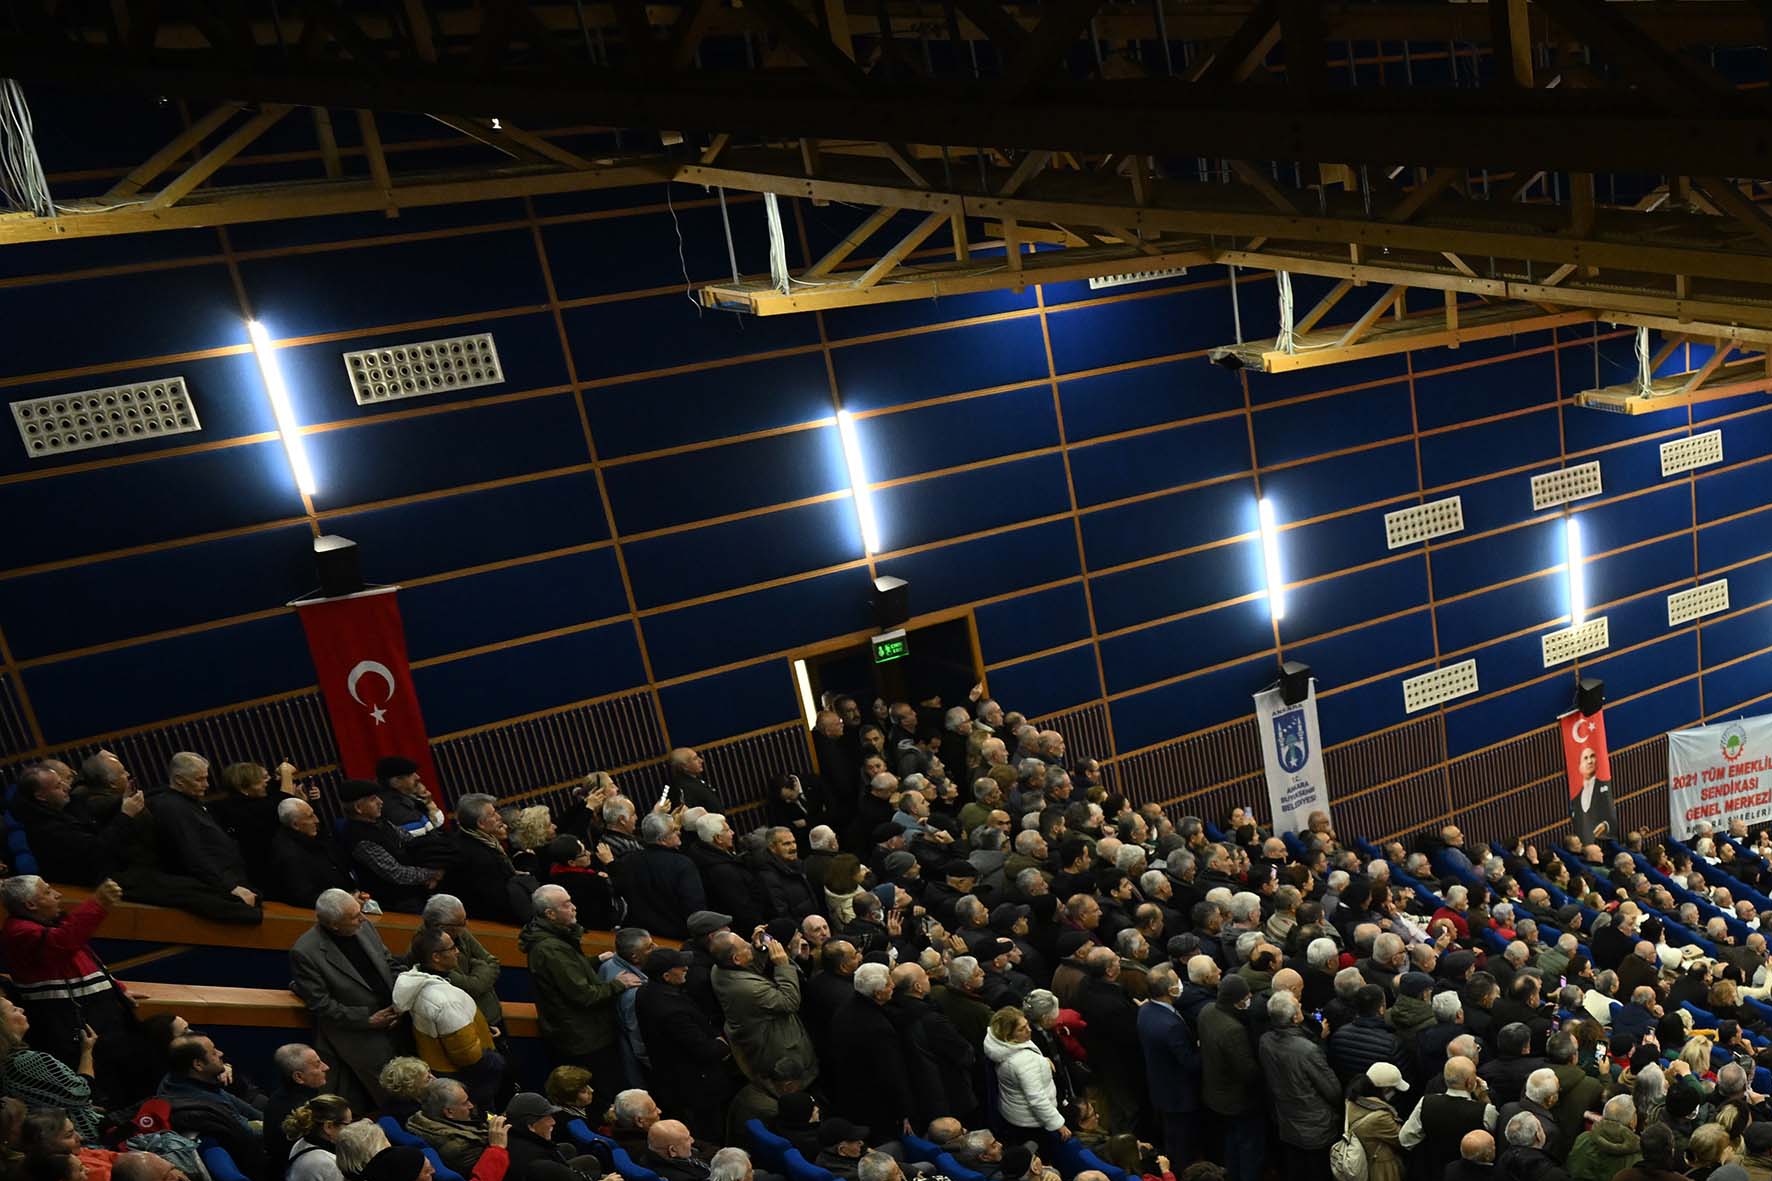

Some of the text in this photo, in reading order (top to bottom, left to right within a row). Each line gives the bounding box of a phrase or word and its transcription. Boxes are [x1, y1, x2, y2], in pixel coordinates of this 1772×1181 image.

[1672, 772, 1698, 791] 2021
[1702, 767, 1725, 784] TÜM
[1686, 788, 1772, 821] GENEL MERKEZİ
